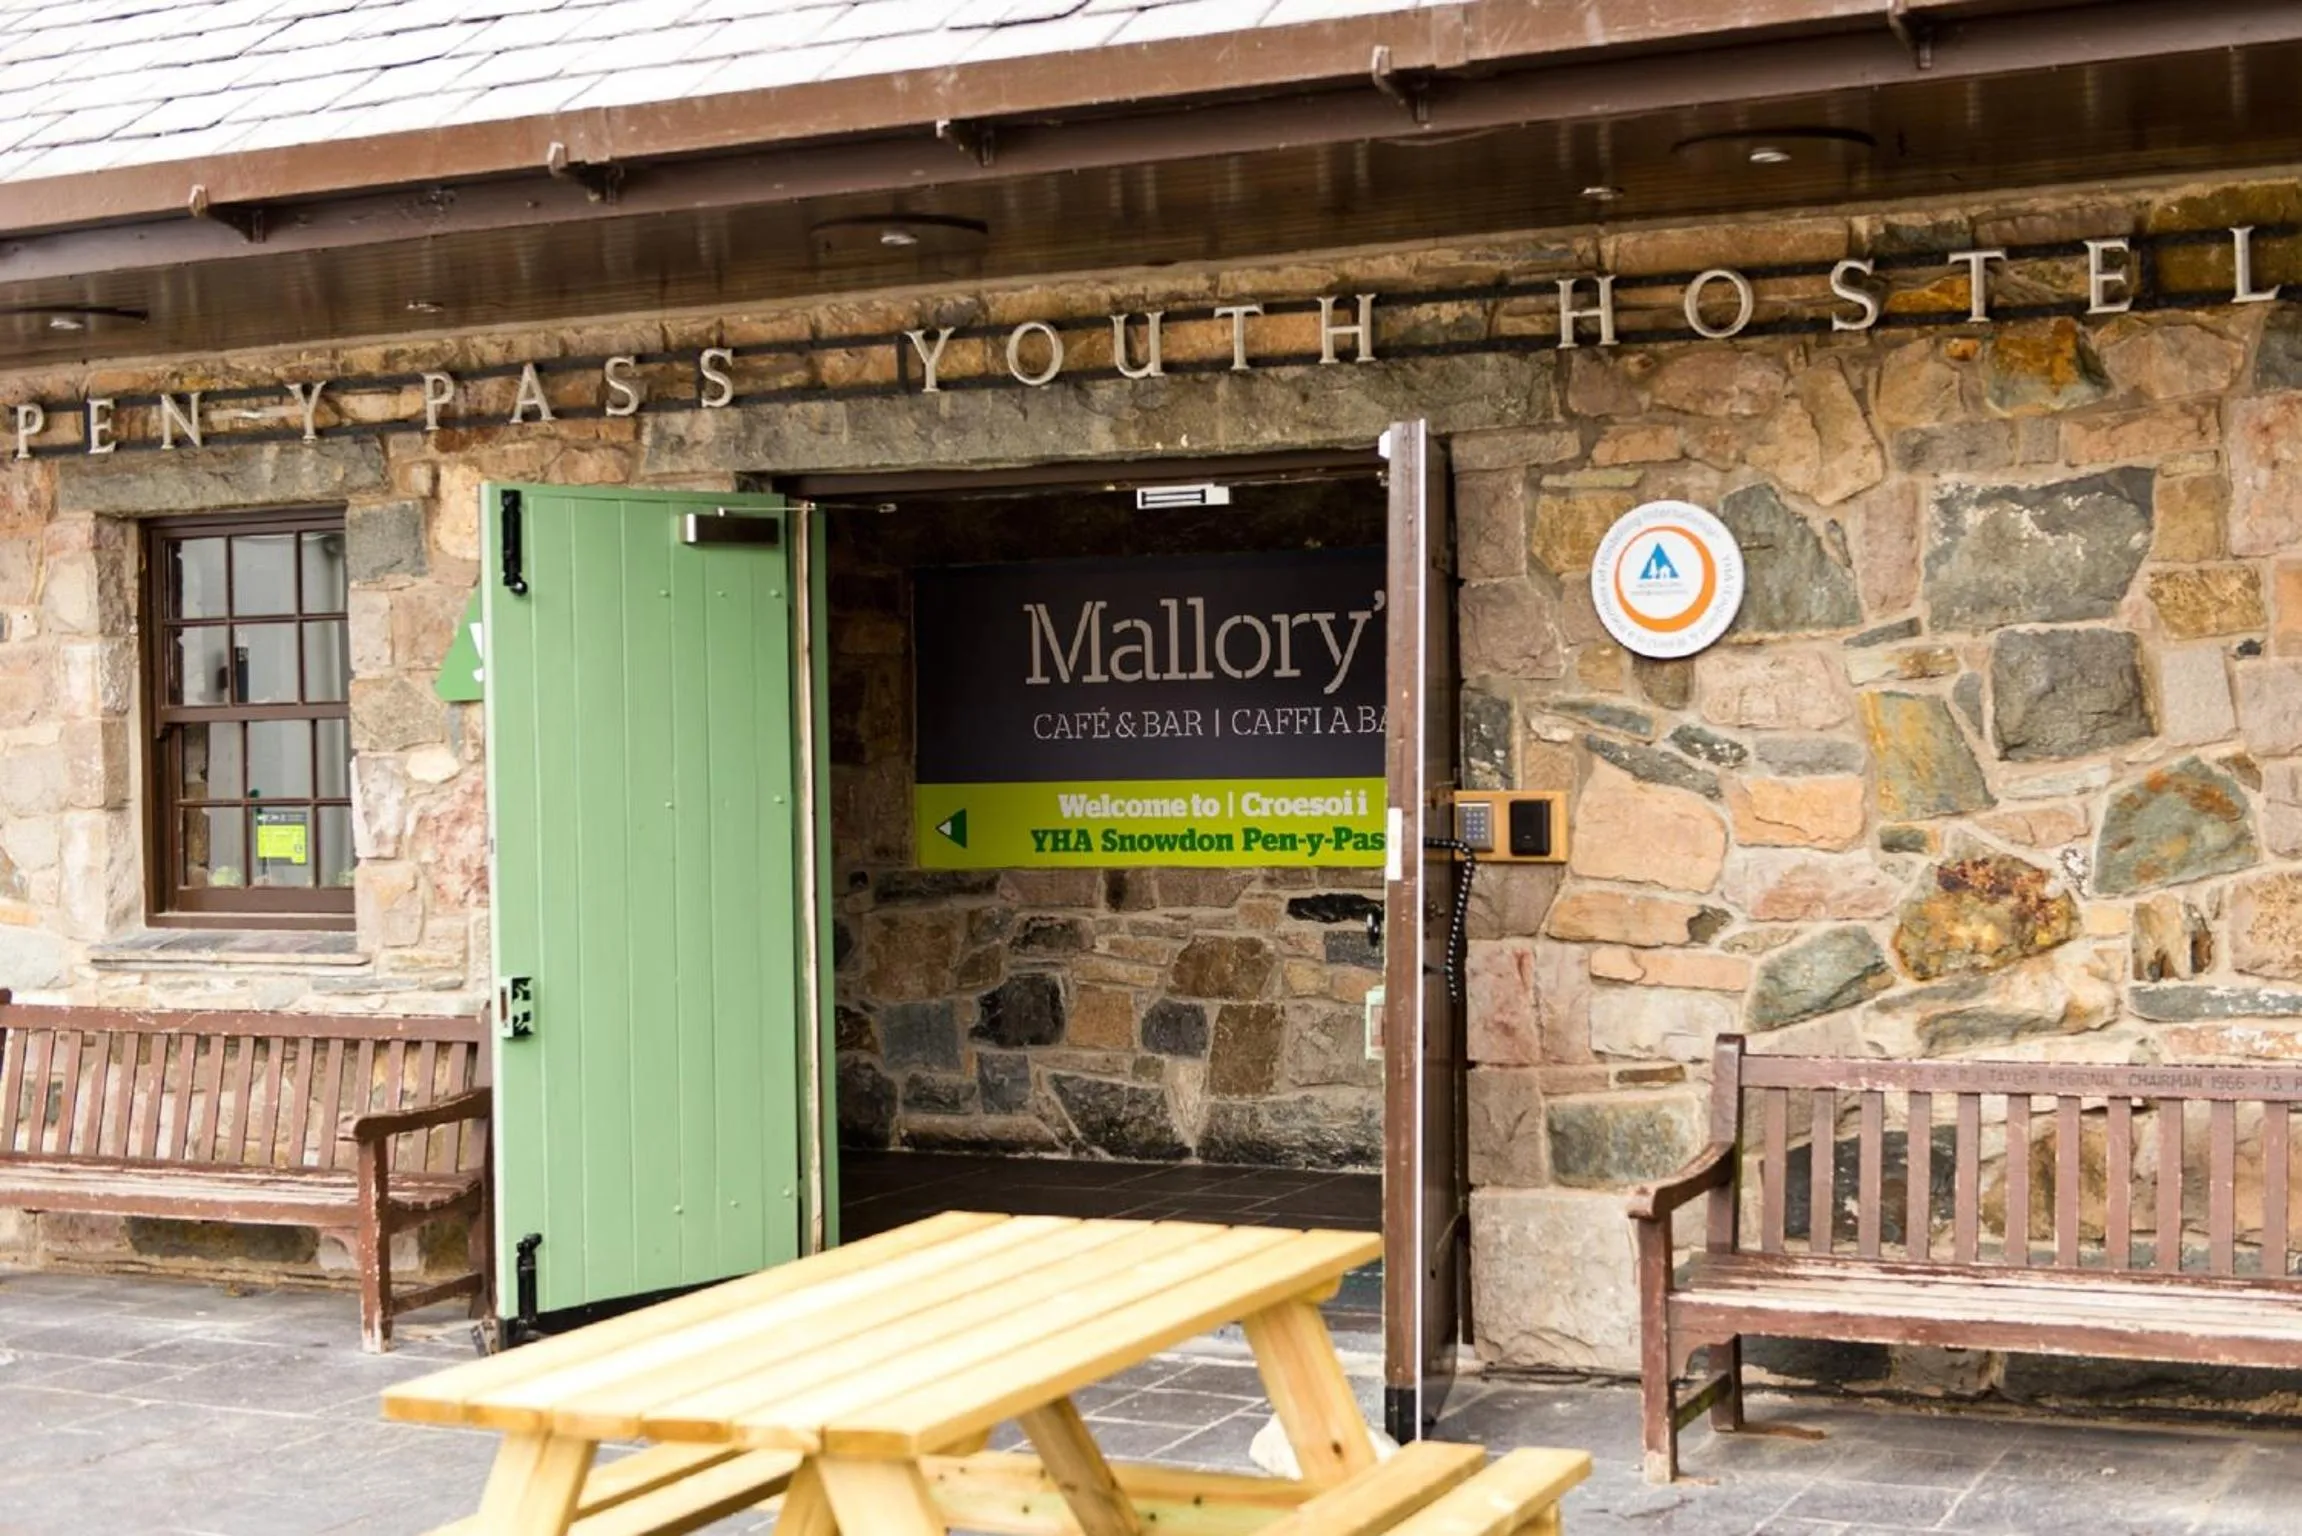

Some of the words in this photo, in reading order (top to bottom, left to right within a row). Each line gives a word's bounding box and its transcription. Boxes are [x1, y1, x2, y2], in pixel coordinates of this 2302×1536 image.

[421, 347, 736, 431] PASS
[904, 293, 1378, 392] YOUTH
[1556, 225, 2282, 348] HOSTEL
[1033, 706, 1111, 739] CAFÉ
[1115, 711, 1137, 738] &
[1142, 709, 1203, 737] BAR
[1232, 707, 1322, 735] CAFFI
[1328, 706, 1350, 734] A
[1057, 793, 1188, 818] Welcome
[1191, 793, 1221, 817] to
[1241, 791, 1353, 816] Croesoi
[1356, 790, 1369, 816] i
[1030, 829, 1093, 852] YHA
[1101, 827, 1234, 852] Snowdon
[2128, 1072, 2202, 1089] CHAIRMAN
[2211, 1075, 2246, 1091] 1966
